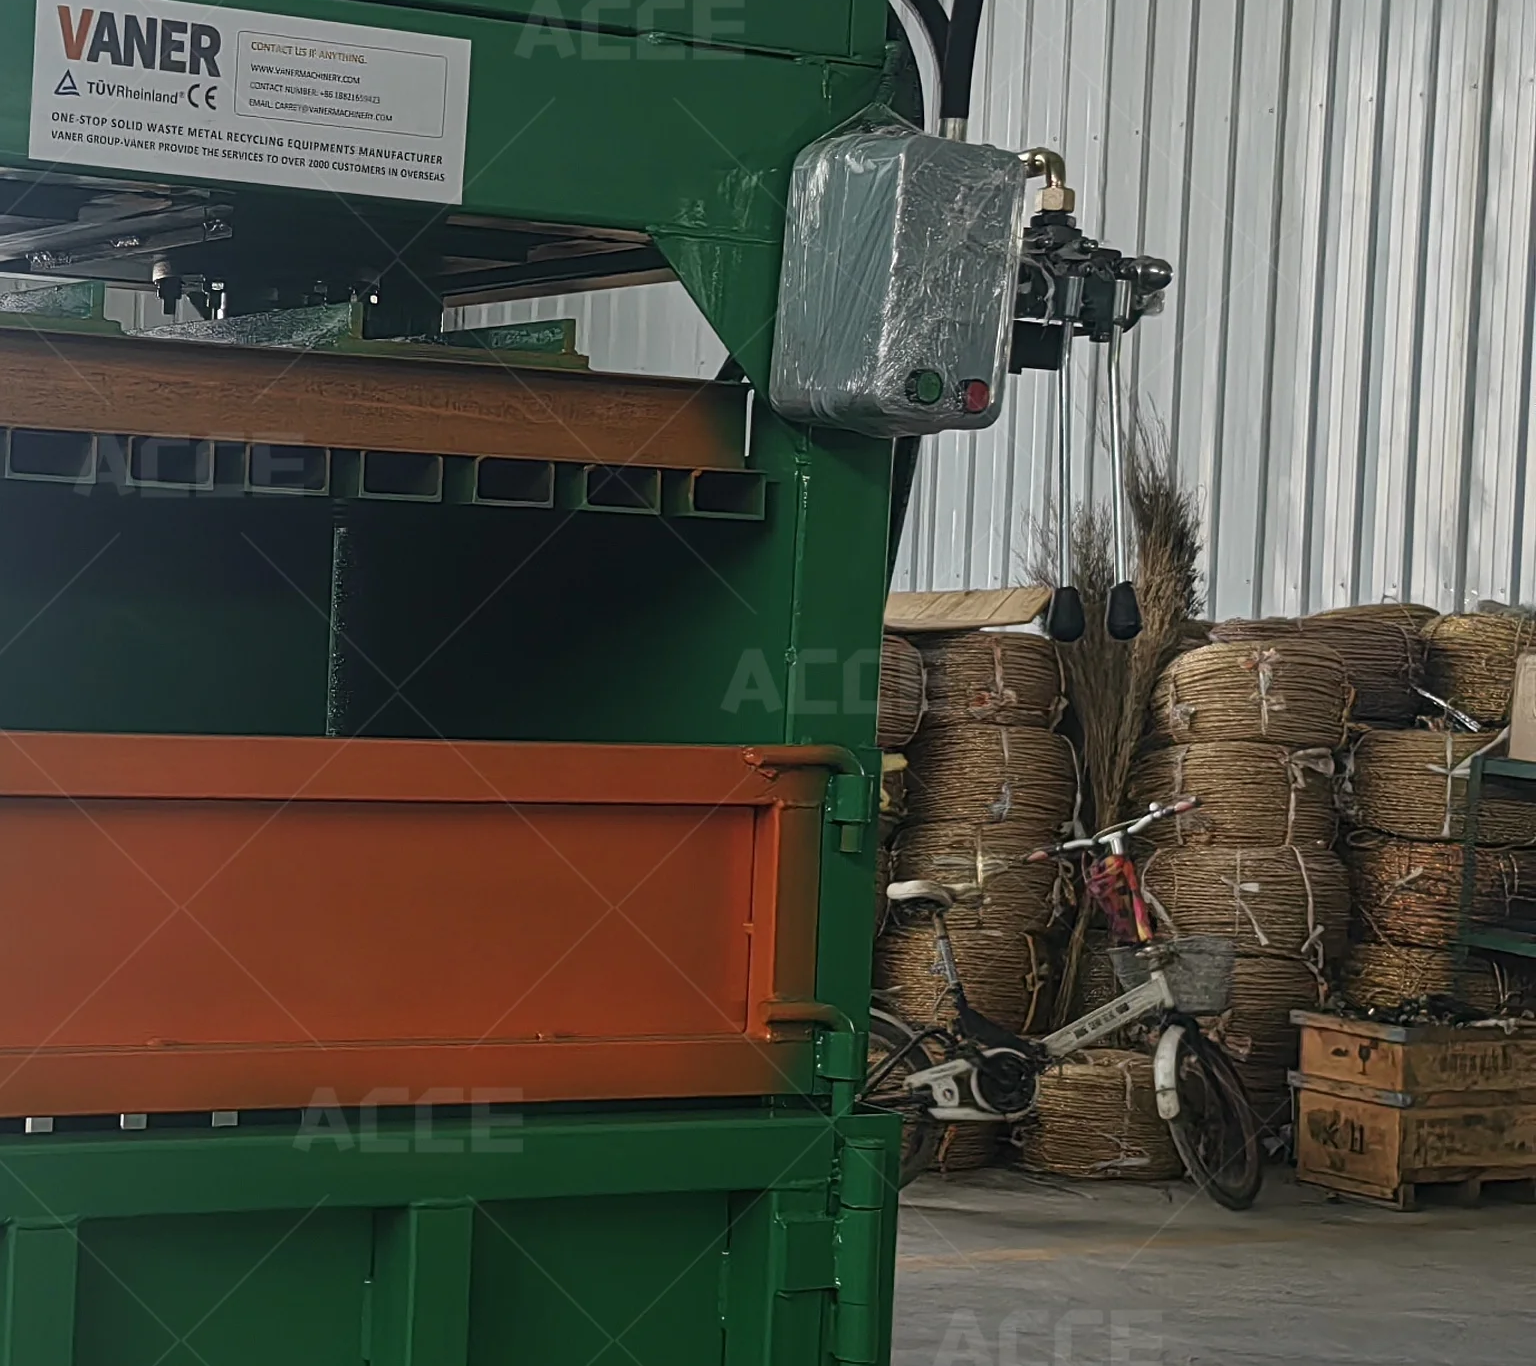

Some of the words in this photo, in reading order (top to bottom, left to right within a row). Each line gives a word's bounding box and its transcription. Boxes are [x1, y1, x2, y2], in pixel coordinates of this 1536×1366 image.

[57, 5, 221, 78] VANER
[251, 41, 293, 54] CONTACT
[295, 46, 307, 56] US
[250, 81, 283, 92] CONTACT
[51, 112, 107, 126] ONE-STOP
[111, 118, 143, 131] SOLID
[147, 123, 184, 136] WASTE
[187, 128, 223, 140] METAL
[226, 132, 284, 147] RECYCLING
[287, 139, 355, 155] EQUIPMENTS
[358, 146, 443, 165] MANUFACTURER
[51, 130, 83, 142] VANER
[86, 134, 155, 150] GROUP-VANER
[158, 142, 199, 155] PROVIDE
[202, 146, 219, 157] THE
[222, 149, 263, 163] SERVICES
[267, 154, 279, 164] TO
[281, 156, 305, 167] OVER
[308, 159, 329, 169] 2000
[332, 161, 385, 175] CUSTOMERS
[388, 167, 398, 177] IN
[400, 168, 445, 182] OVERSEAS
